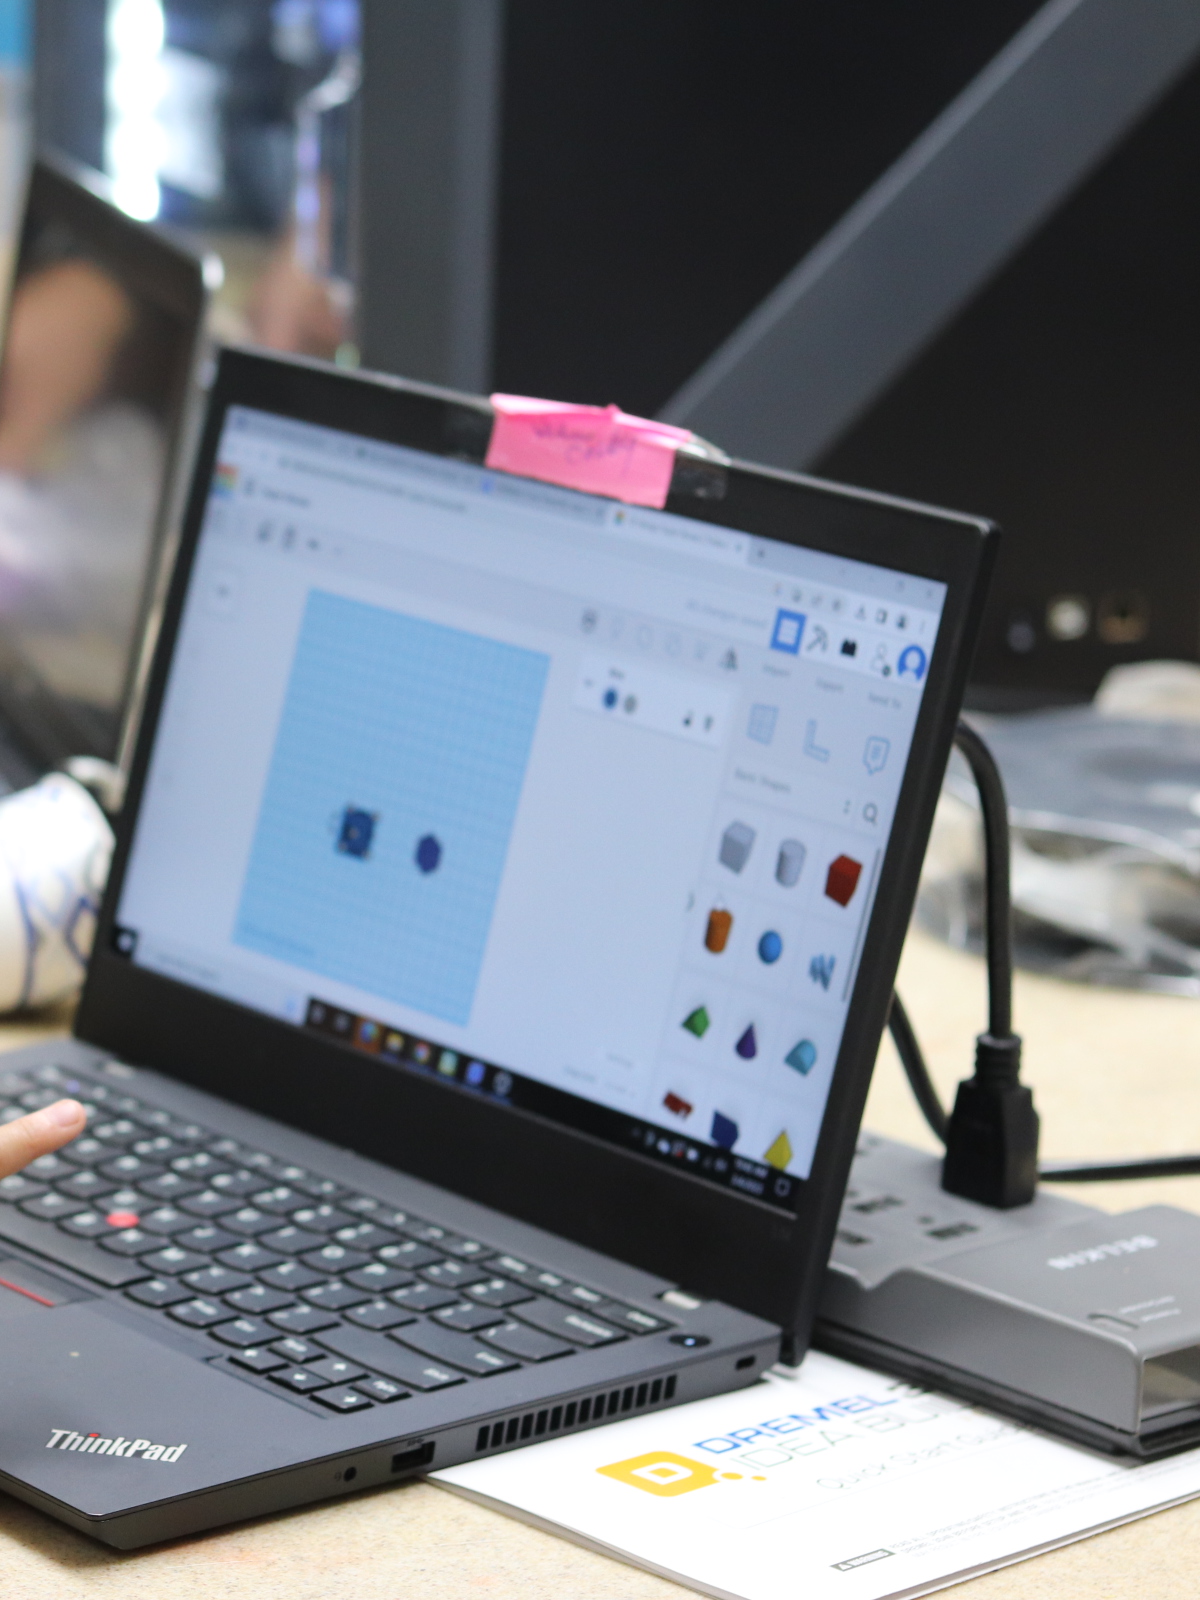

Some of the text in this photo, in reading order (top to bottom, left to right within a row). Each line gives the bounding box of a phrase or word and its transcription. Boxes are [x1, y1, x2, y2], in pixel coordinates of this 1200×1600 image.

[692, 1395, 899, 1454] DREMEL
[45, 1428, 188, 1463] ThinkPad
[730, 1430, 865, 1470] IDEA
[816, 1463, 896, 1489] Quick
